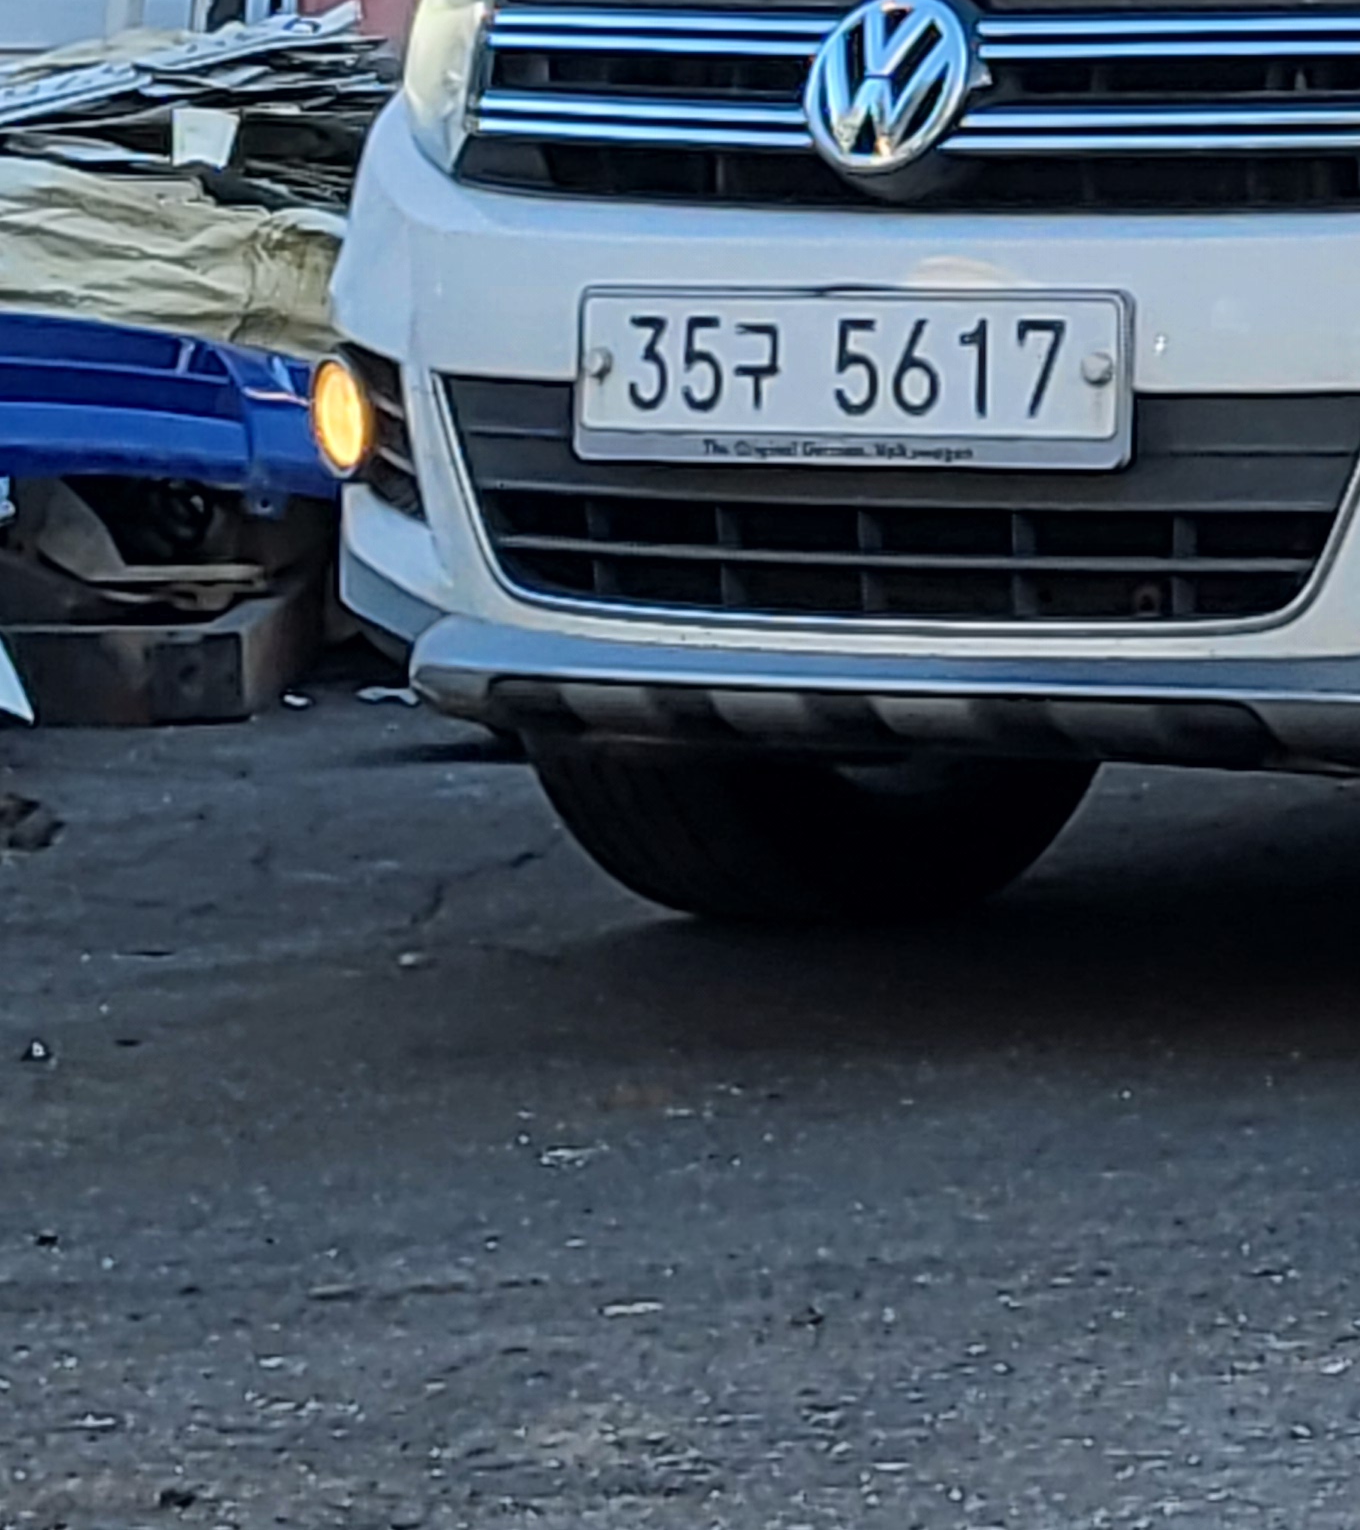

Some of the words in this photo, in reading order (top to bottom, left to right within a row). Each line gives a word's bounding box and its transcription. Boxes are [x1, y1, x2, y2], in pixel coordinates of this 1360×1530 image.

[628, 315, 781, 412] 35구
[833, 317, 1067, 419] 5617
[702, 438, 730, 457] The
